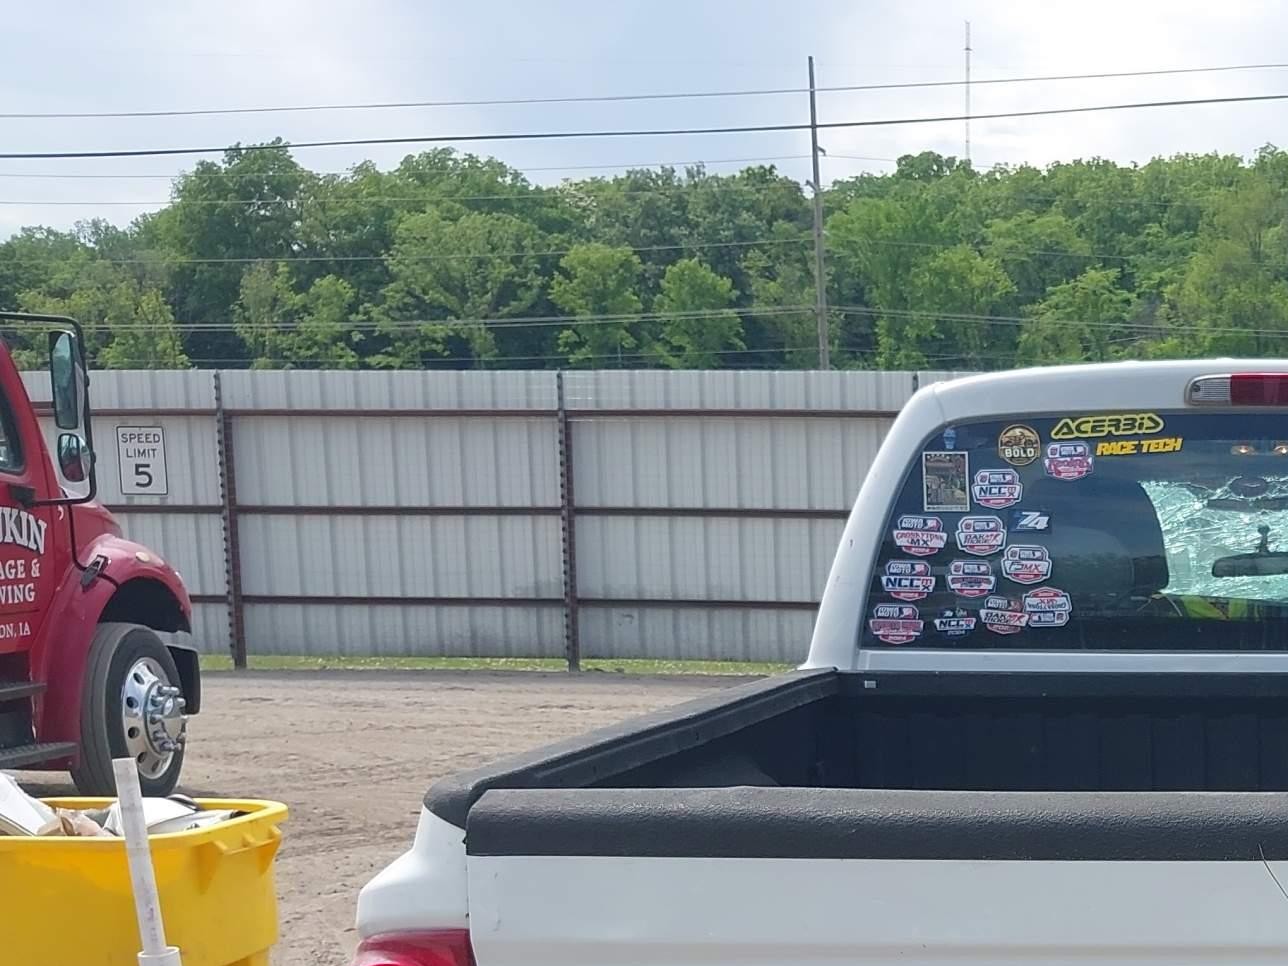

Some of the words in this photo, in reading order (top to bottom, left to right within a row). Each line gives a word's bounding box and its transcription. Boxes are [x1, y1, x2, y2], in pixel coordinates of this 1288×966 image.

[121, 433, 161, 443] SPEED
[126, 448, 157, 459] LIMIT
[134, 464, 153, 488] 5
[31, 558, 40, 578] &
[19, 621, 31, 636] IA
